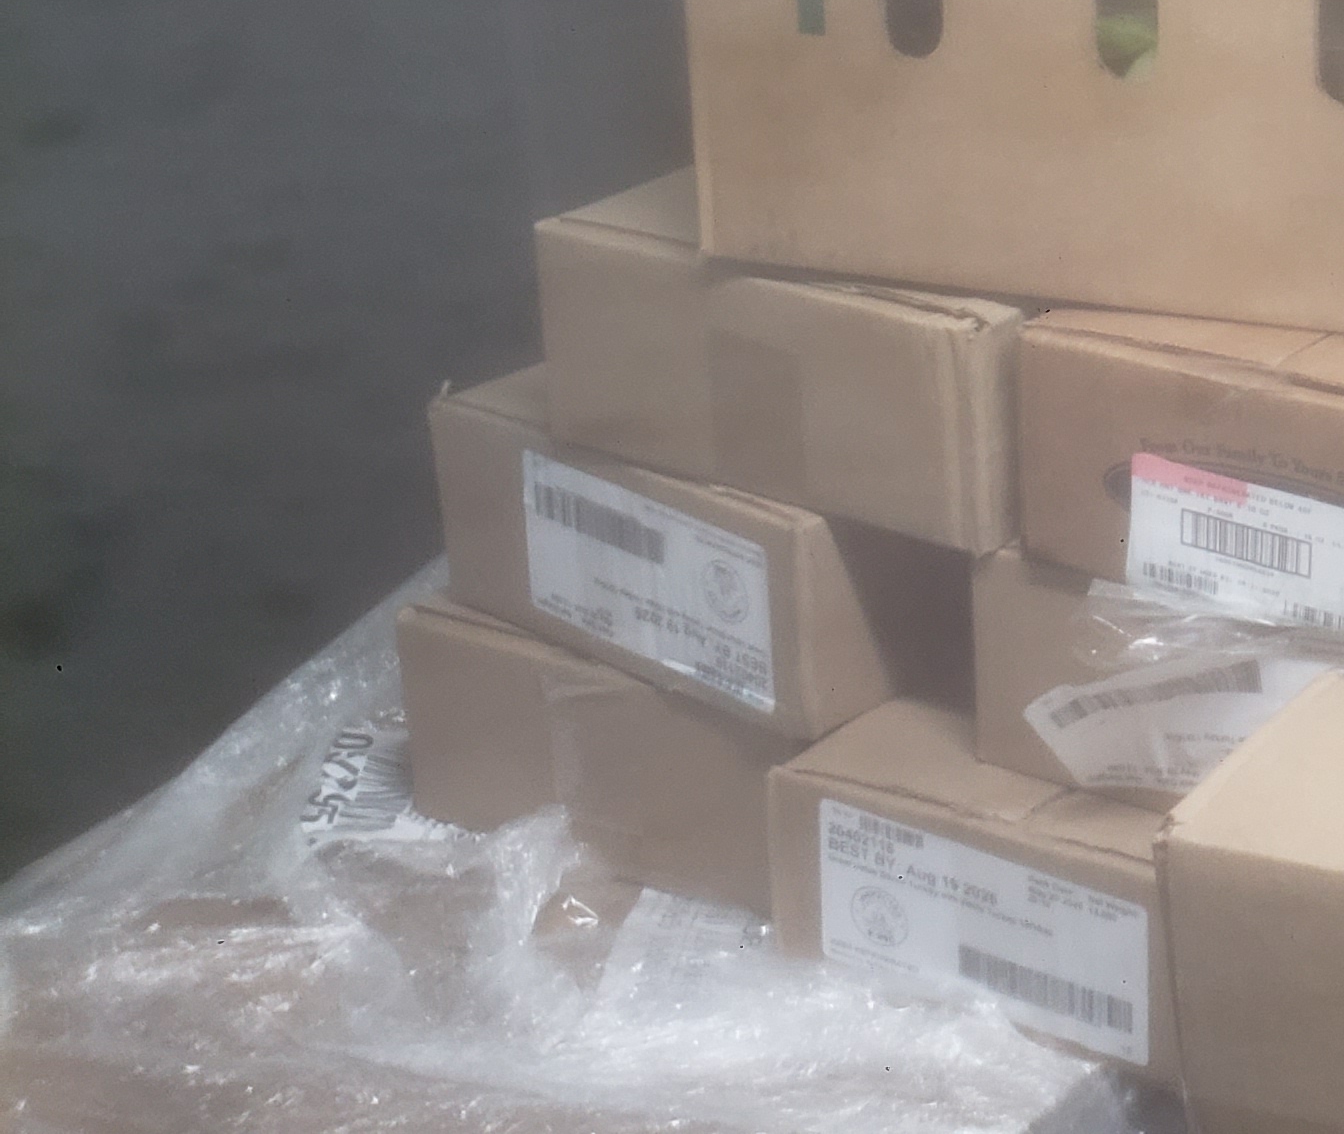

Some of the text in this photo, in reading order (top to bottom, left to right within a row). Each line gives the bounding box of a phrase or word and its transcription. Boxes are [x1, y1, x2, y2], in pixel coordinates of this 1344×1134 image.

[1182, 440, 1210, 456] Our
[1216, 443, 1265, 465] Family
[1293, 457, 1333, 480] Yours
[827, 836, 870, 863] BEST
[906, 863, 936, 887] Aug
